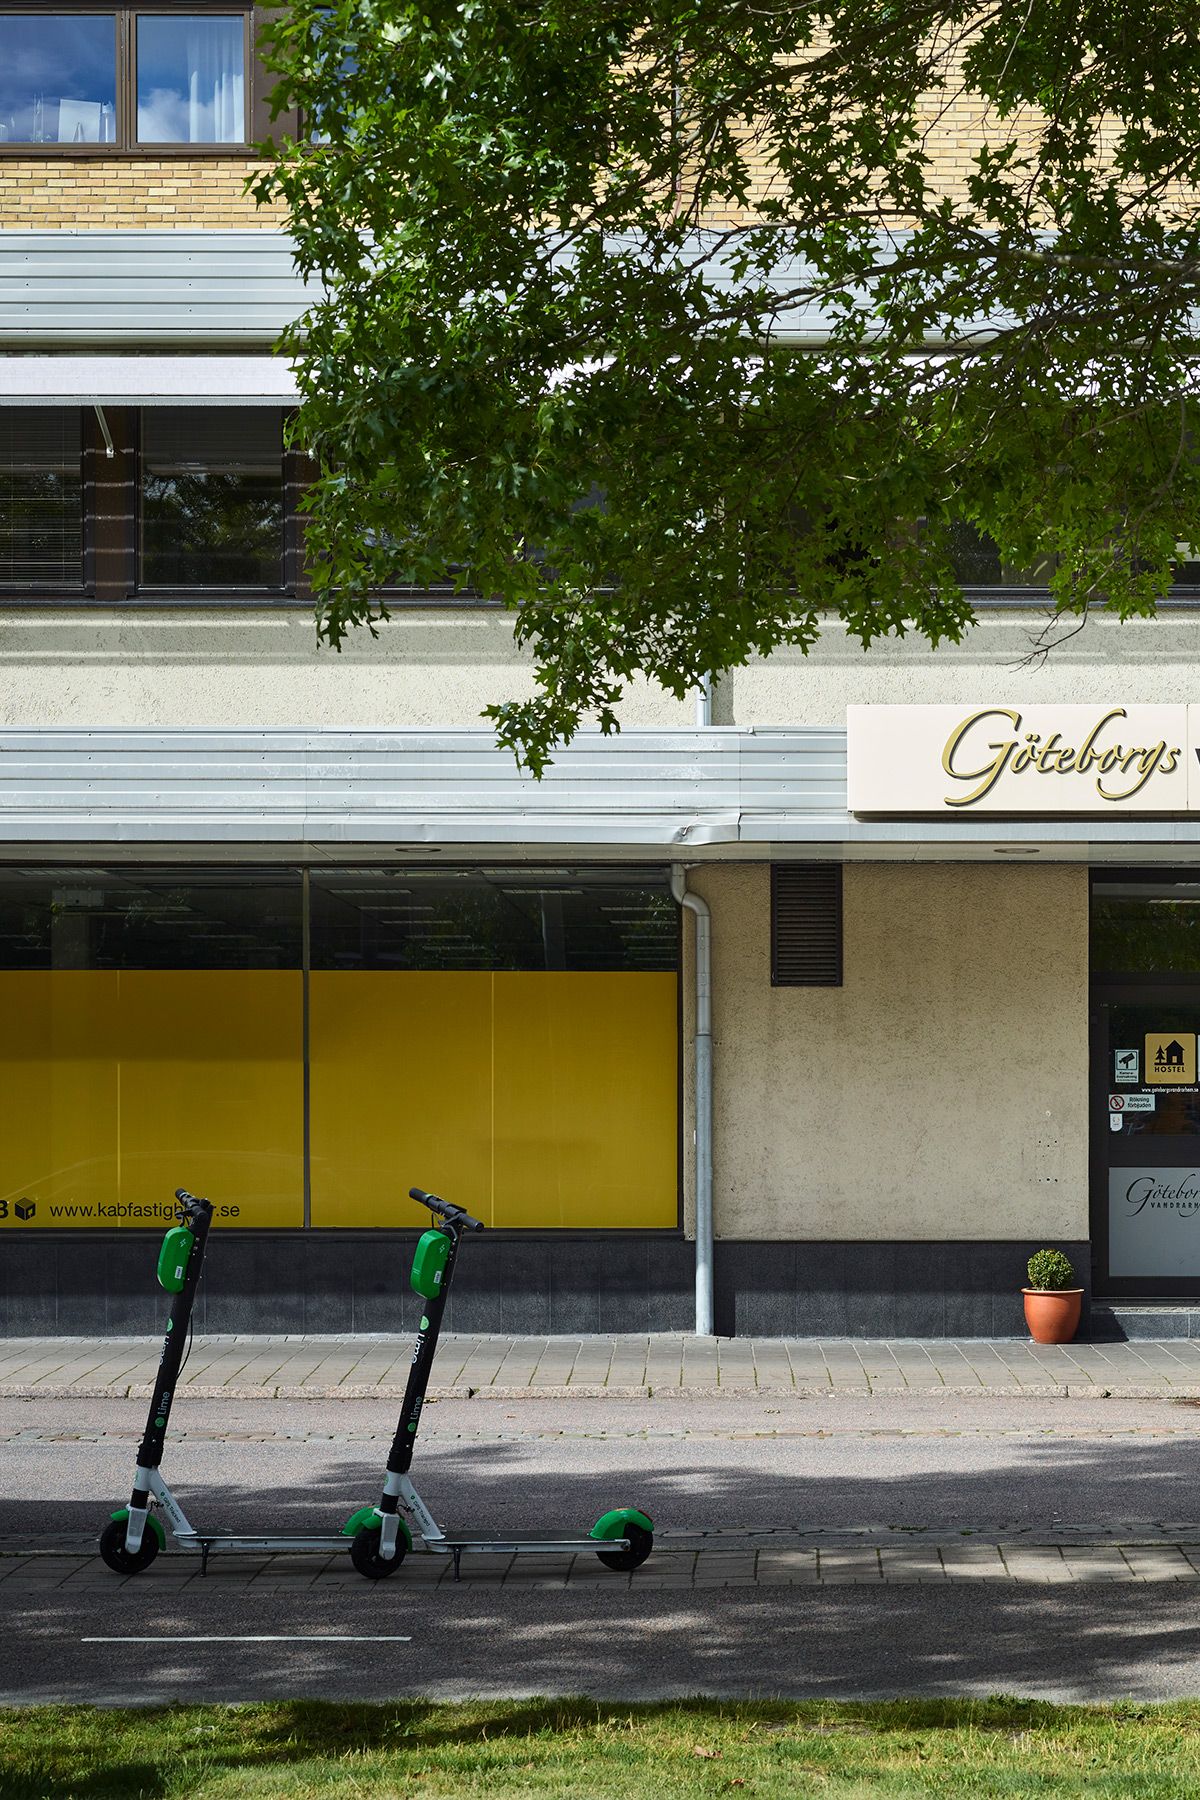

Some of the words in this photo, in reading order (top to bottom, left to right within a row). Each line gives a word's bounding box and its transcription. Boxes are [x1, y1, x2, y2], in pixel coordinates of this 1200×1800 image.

[941, 708, 1182, 807] Göteborgs
[157, 1391, 170, 1415] Lime
[410, 1396, 422, 1420] Lime
